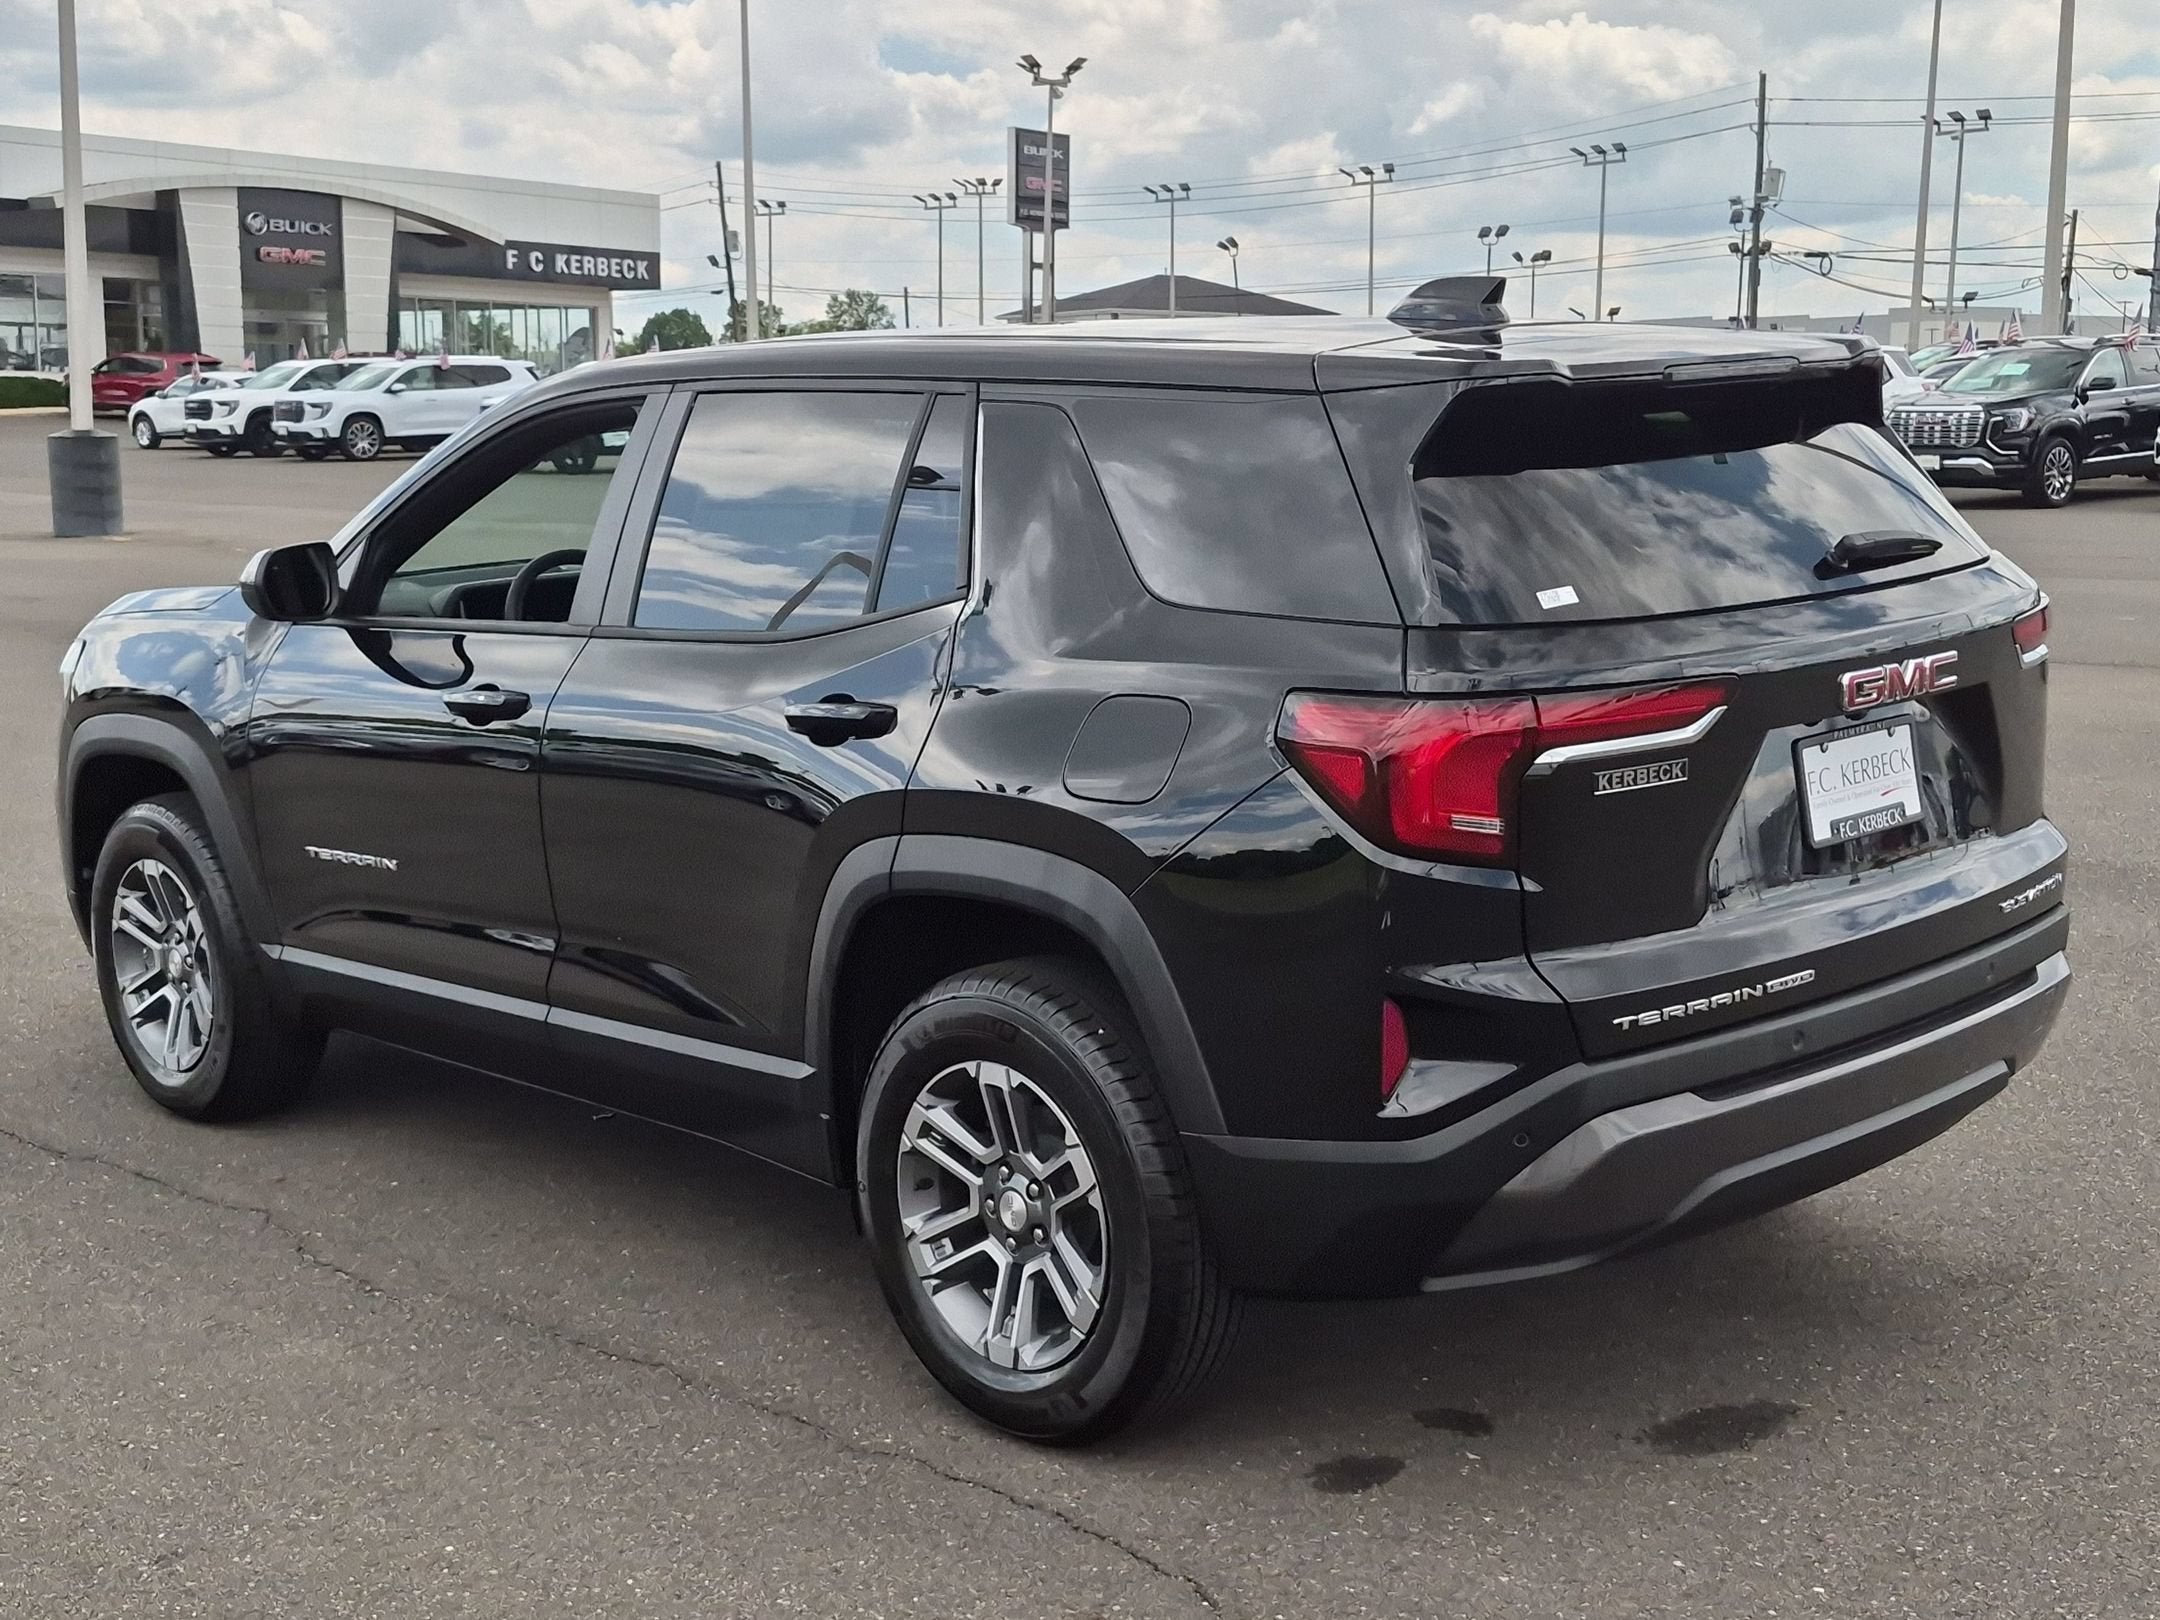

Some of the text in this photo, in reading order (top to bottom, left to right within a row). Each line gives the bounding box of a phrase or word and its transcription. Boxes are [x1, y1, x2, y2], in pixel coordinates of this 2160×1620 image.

[269, 218, 332, 236] BUICK
[259, 246, 326, 266] GMC
[506, 249, 649, 280] F C KERBECK
[1838, 650, 1958, 712] GMC
[1598, 762, 1684, 791] KERBECK
[1807, 767, 1837, 797] F.C.
[1840, 747, 1912, 788] KERBECK
[1859, 807, 1903, 832] KERBECK
[304, 845, 399, 871] TERRAIN
[1612, 984, 1763, 1030] TERRAIN
